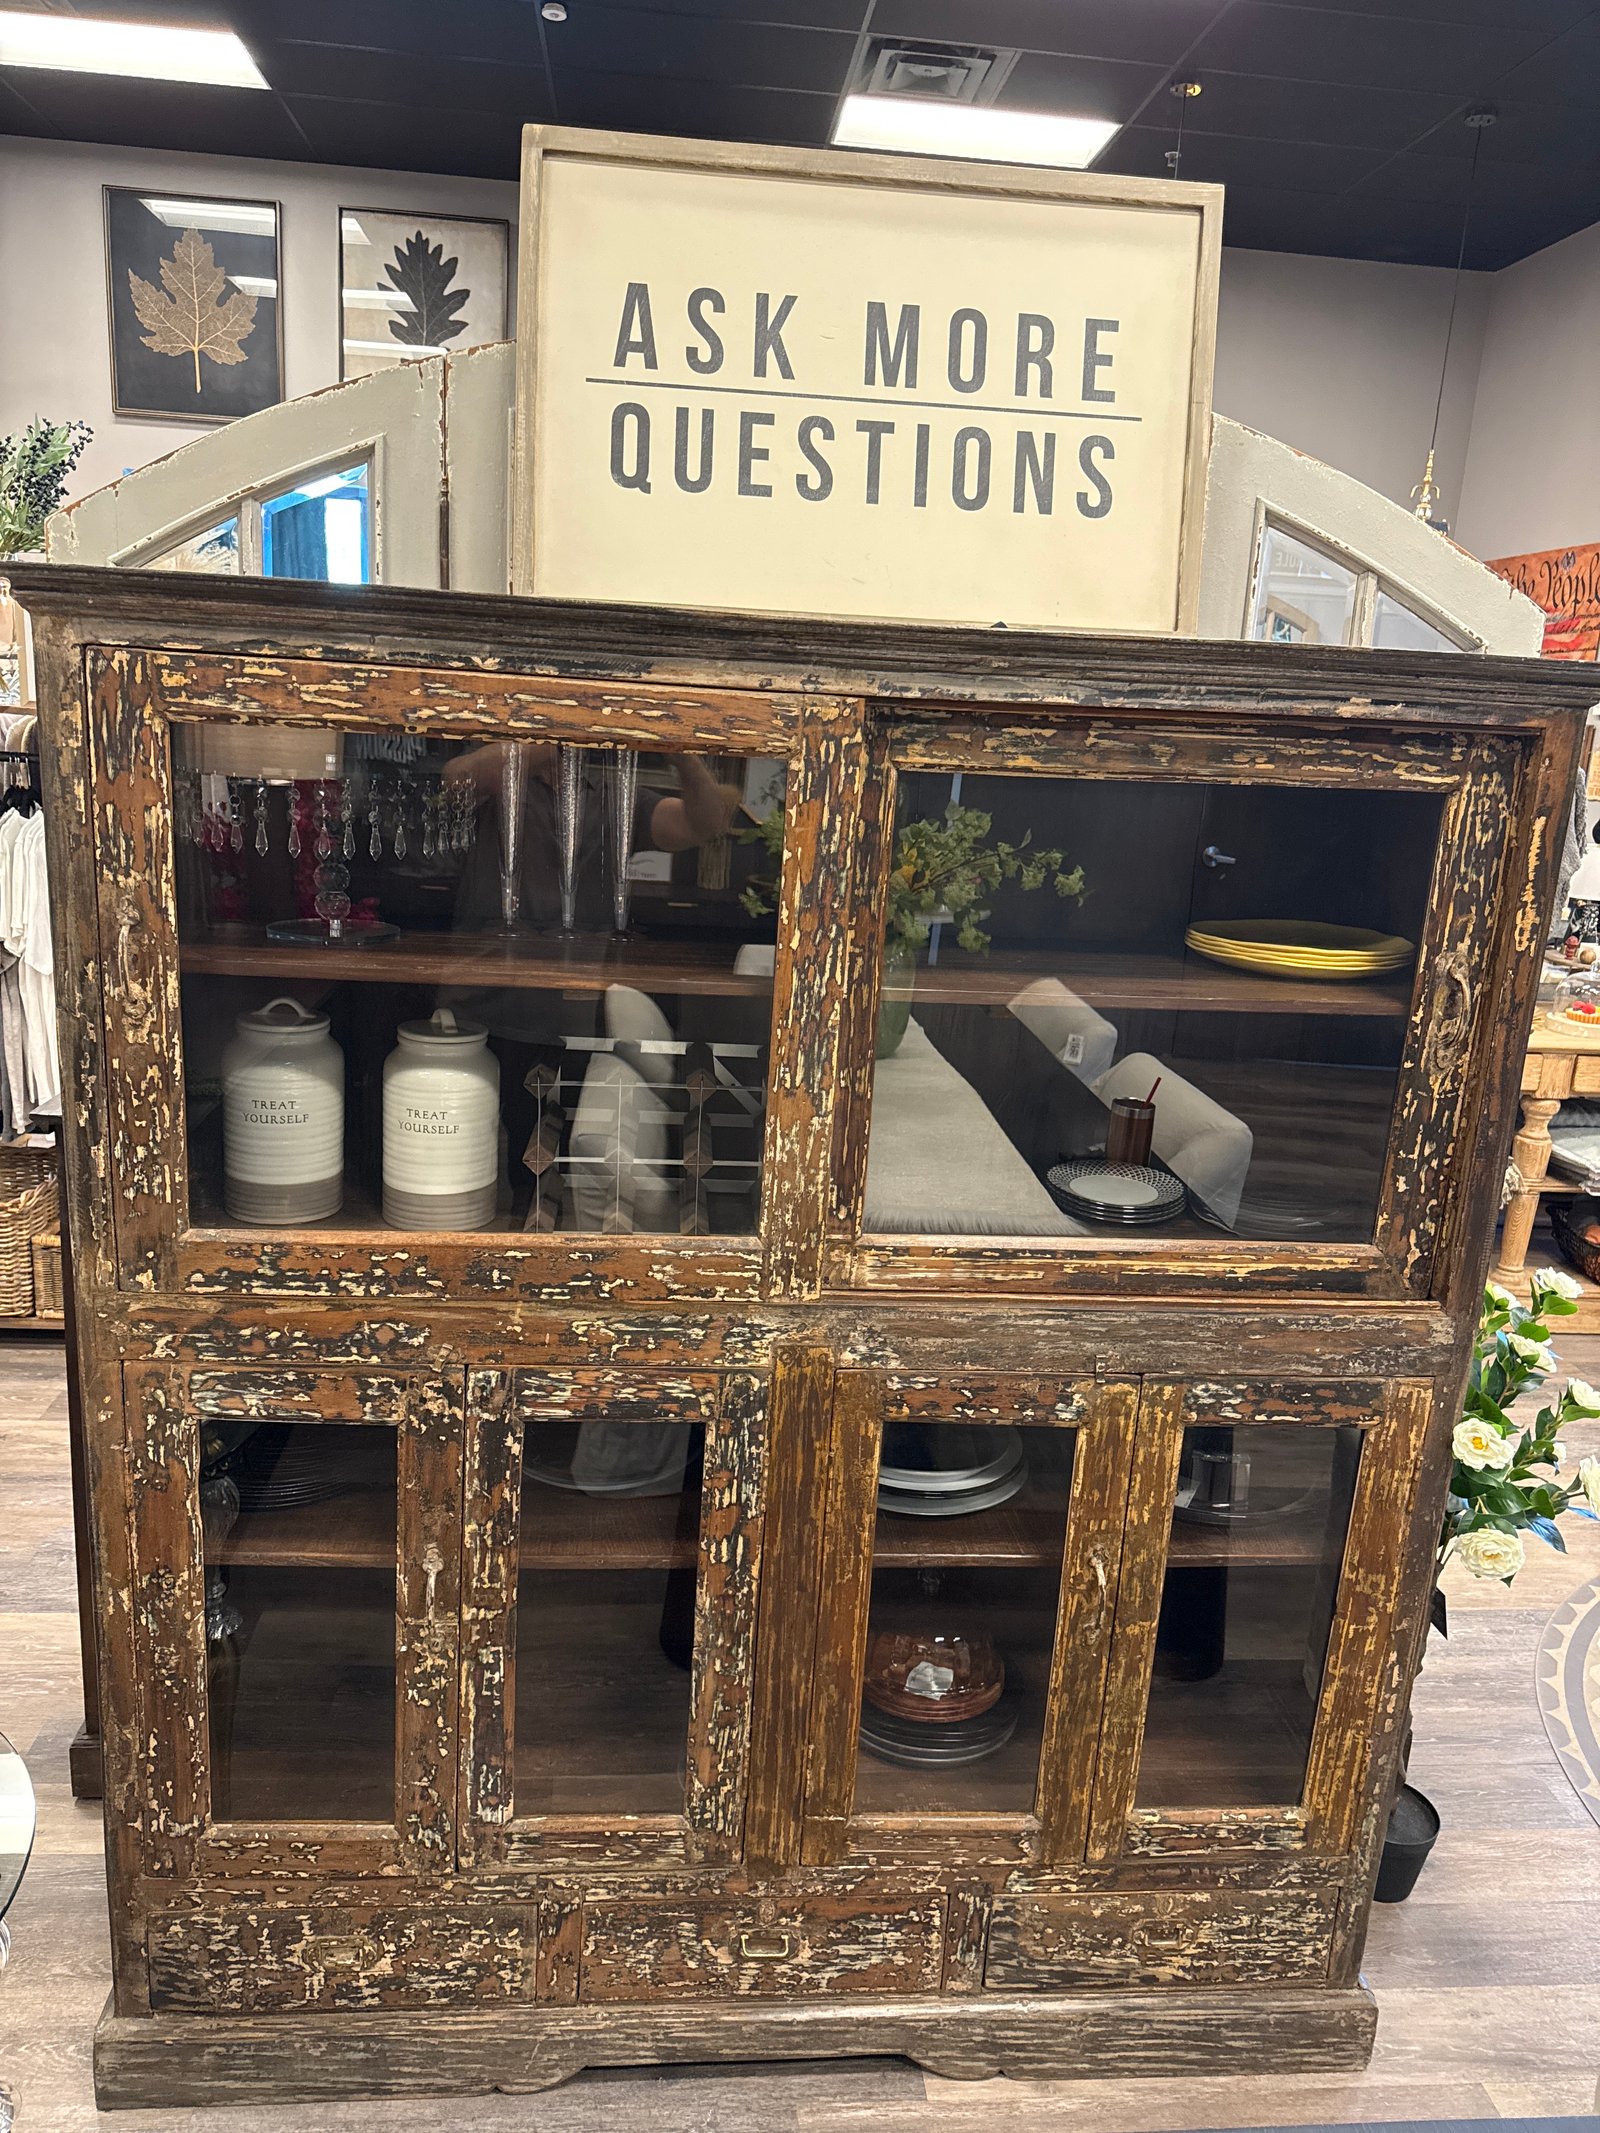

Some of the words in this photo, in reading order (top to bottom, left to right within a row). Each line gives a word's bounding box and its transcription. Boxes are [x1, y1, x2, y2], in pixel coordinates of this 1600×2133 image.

[612, 281, 799, 381] ASK
[863, 301, 1121, 404] MORE
[609, 401, 1116, 519] QUESTIONS
[251, 1099, 297, 1110] TREAT
[242, 1111, 310, 1125] YOURSELF
[406, 1107, 449, 1121] TREAT
[397, 1119, 460, 1135] YOURSELF
